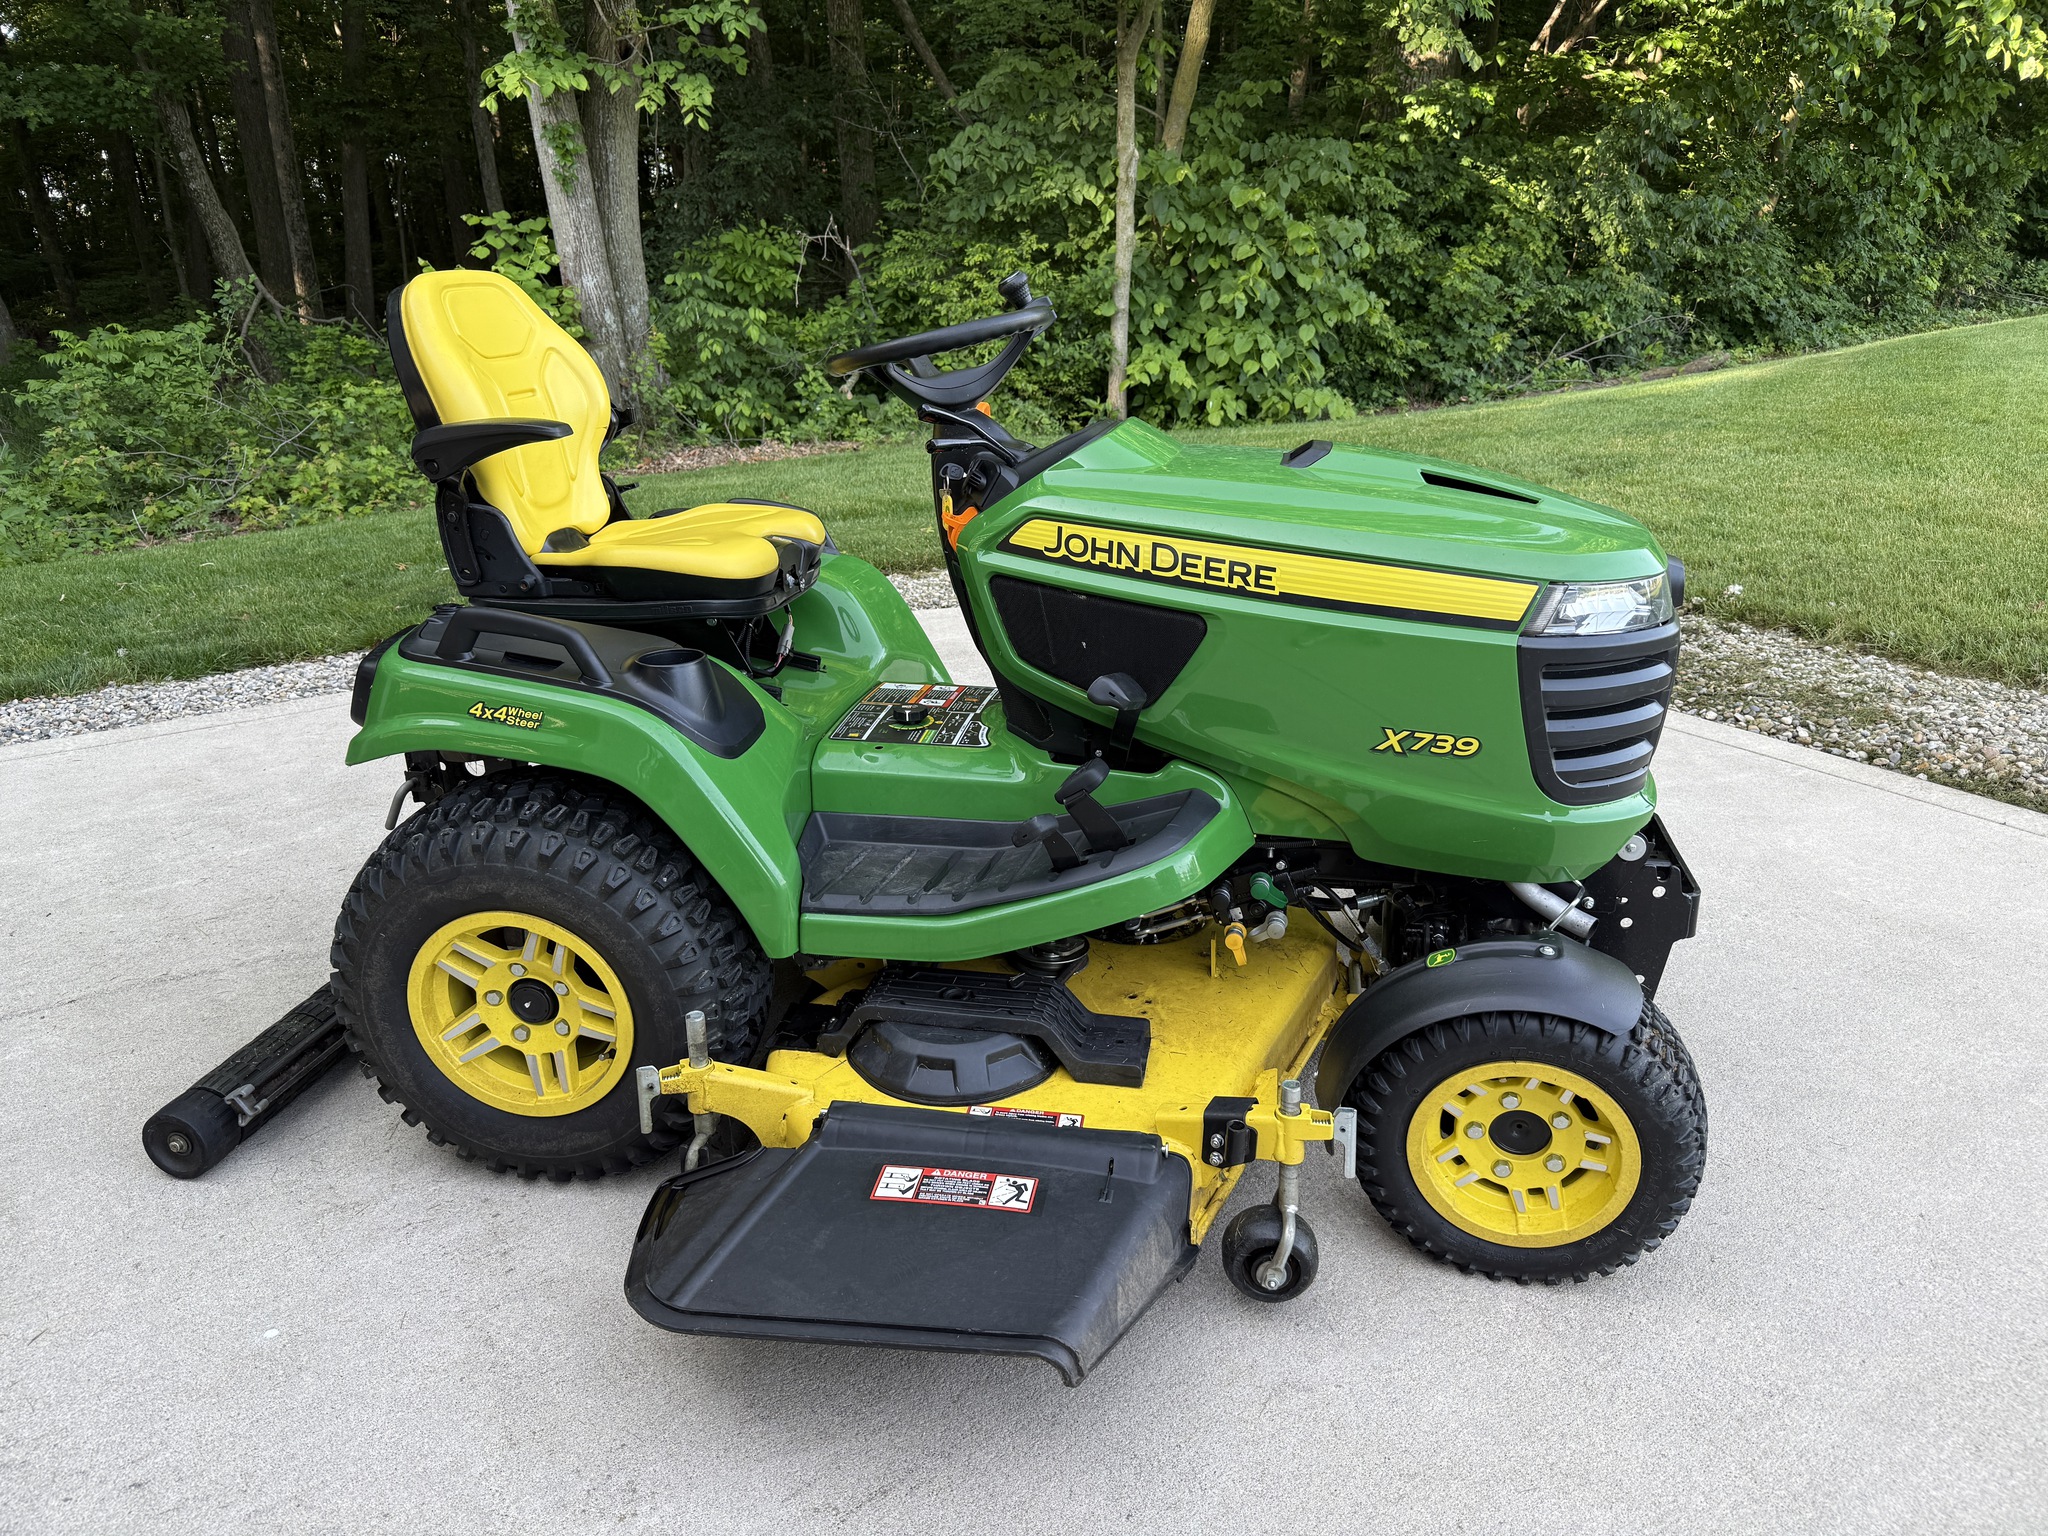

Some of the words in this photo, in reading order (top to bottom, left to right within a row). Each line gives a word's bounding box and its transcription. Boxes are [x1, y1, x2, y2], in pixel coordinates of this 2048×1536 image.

[468, 702, 508, 721] 4x4
[508, 706, 543, 720] Wheel
[506, 715, 541, 729] Steer
[1371, 727, 1481, 757] X739
[942, 1170, 988, 1180] DANGER
